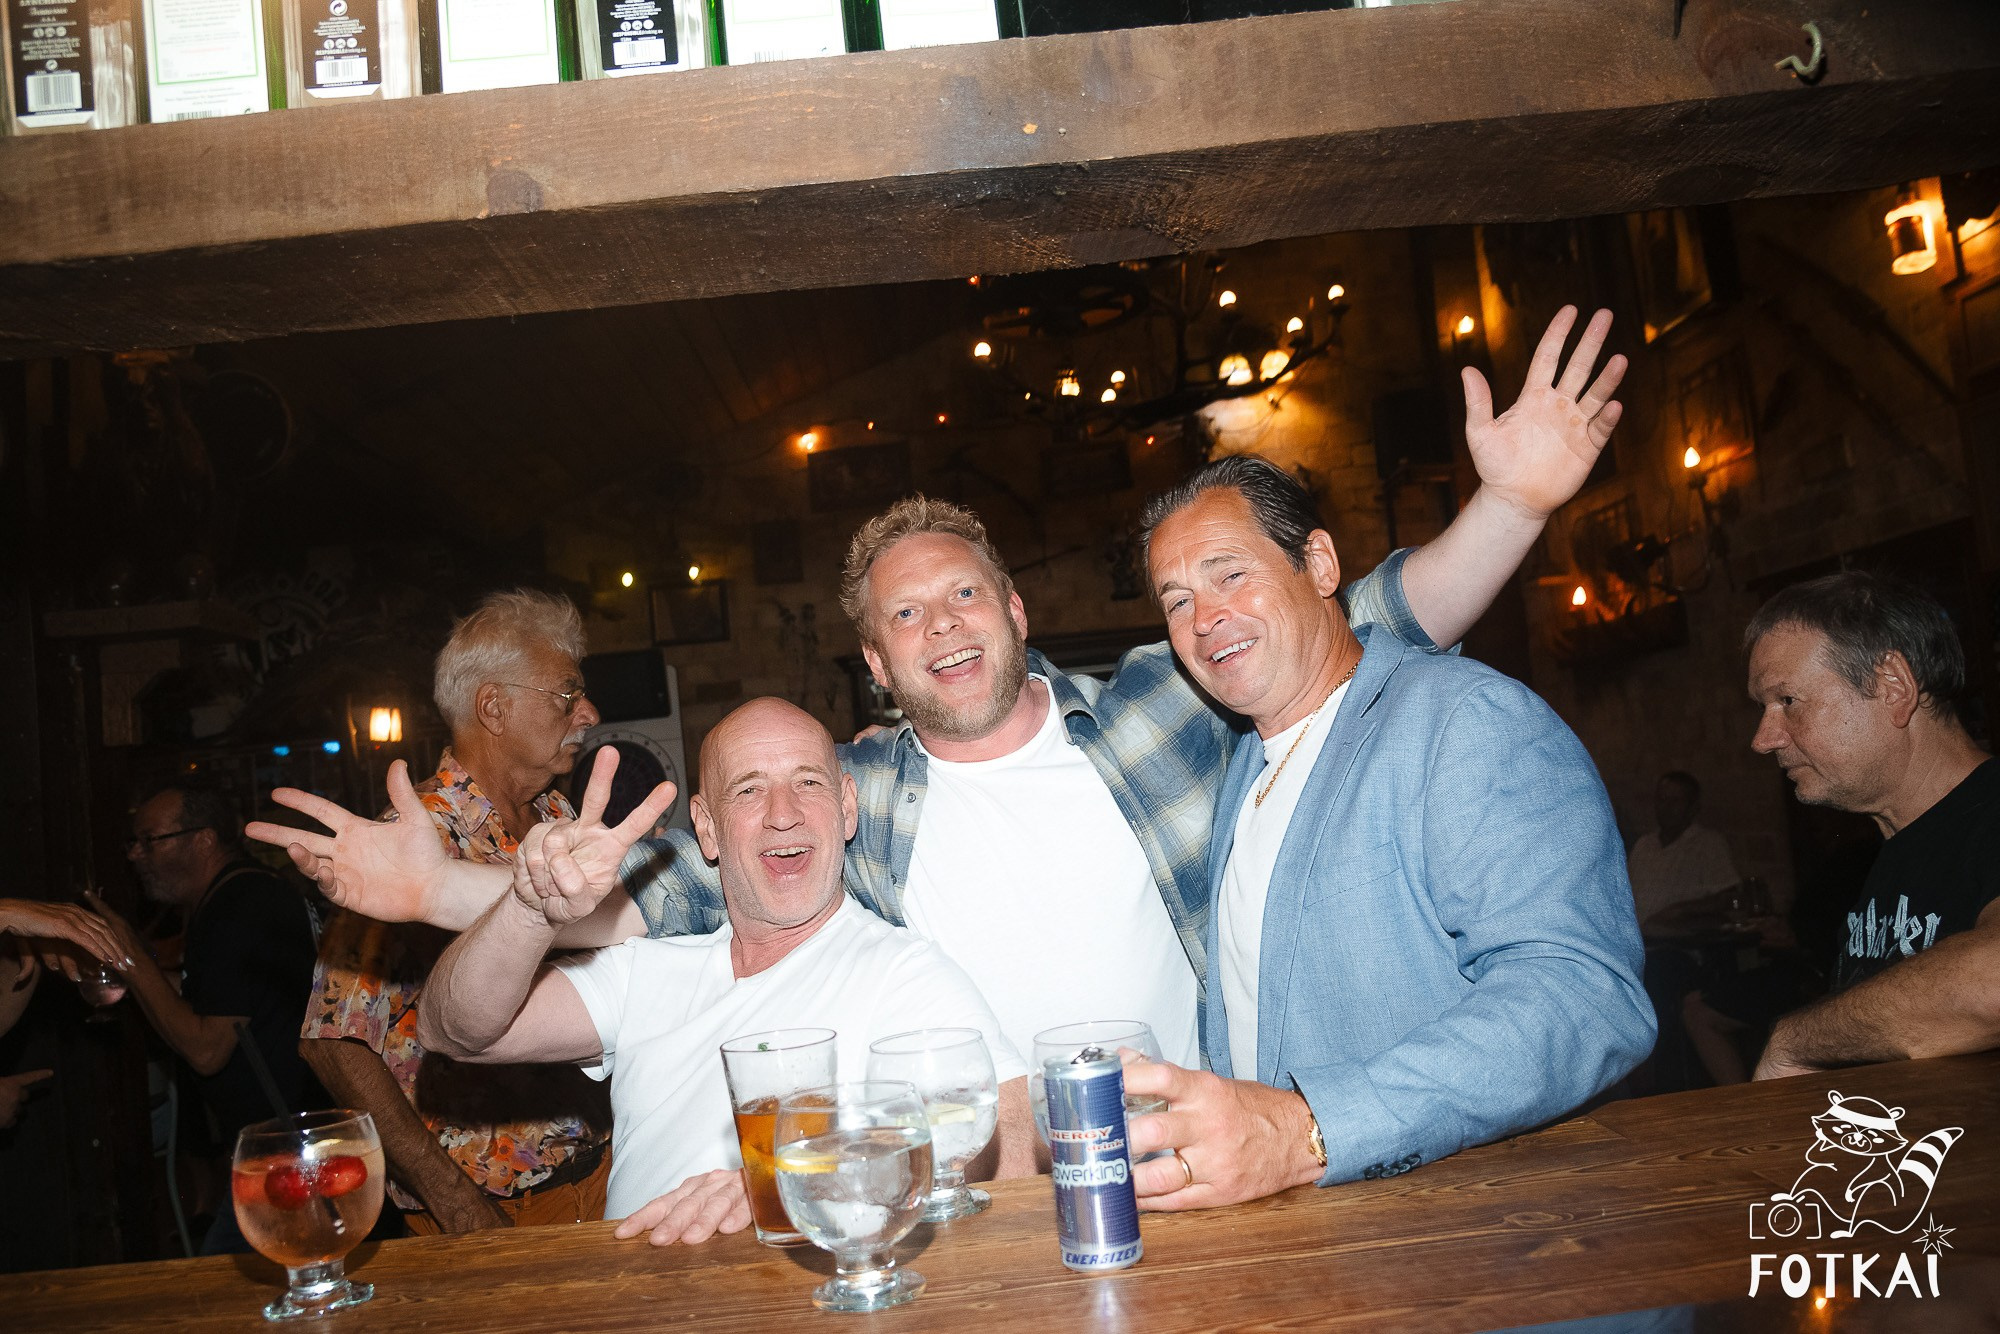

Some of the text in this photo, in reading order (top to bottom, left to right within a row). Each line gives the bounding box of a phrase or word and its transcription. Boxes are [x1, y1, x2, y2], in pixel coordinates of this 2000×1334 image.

[1050, 1126, 1111, 1140] NERGY
[1087, 1140, 1123, 1152] drink
[1053, 1163, 1125, 1182] owerking
